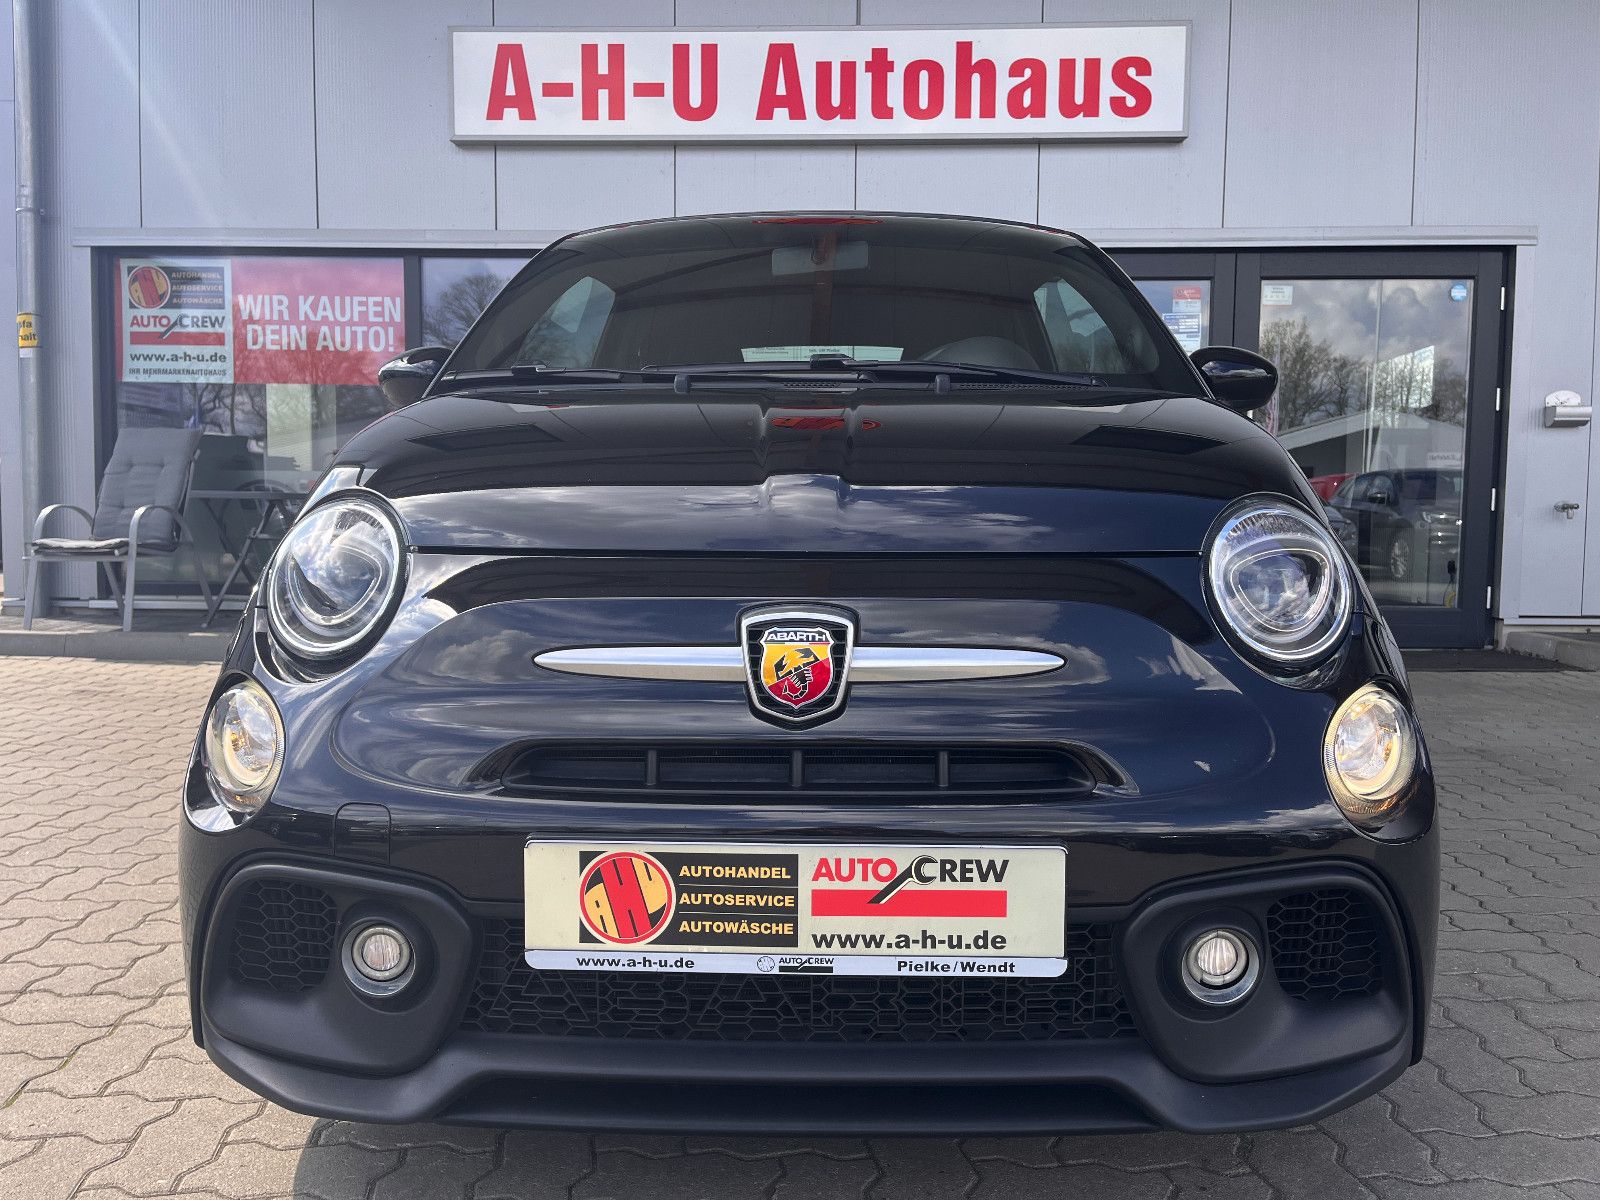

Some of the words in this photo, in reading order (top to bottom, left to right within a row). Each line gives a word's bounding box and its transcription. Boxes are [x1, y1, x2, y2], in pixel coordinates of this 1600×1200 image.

[486, 43, 718, 121] A-H-U
[755, 41, 1153, 121] Autohaus
[171, 271, 221, 279] AUTOHANDEL
[237, 294, 289, 321] WIR
[298, 295, 401, 323] KAUFEN
[246, 324, 307, 351] DEIN
[316, 325, 395, 352] AUTO!
[130, 352, 227, 363] www.a-h-u.de
[129, 367, 140, 375] IHR
[142, 367, 227, 377] MEHRMARKENAUTOHAUS
[766, 632, 826, 641] ABARTH
[679, 865, 791, 879] AUTOHANDEL
[679, 893, 795, 907] AUTOSERVICE
[679, 920, 794, 935] AUTOWÄSCHE
[811, 929, 1007, 950] www.a-h-u.de
[576, 956, 695, 969] www.a-h-u.de
